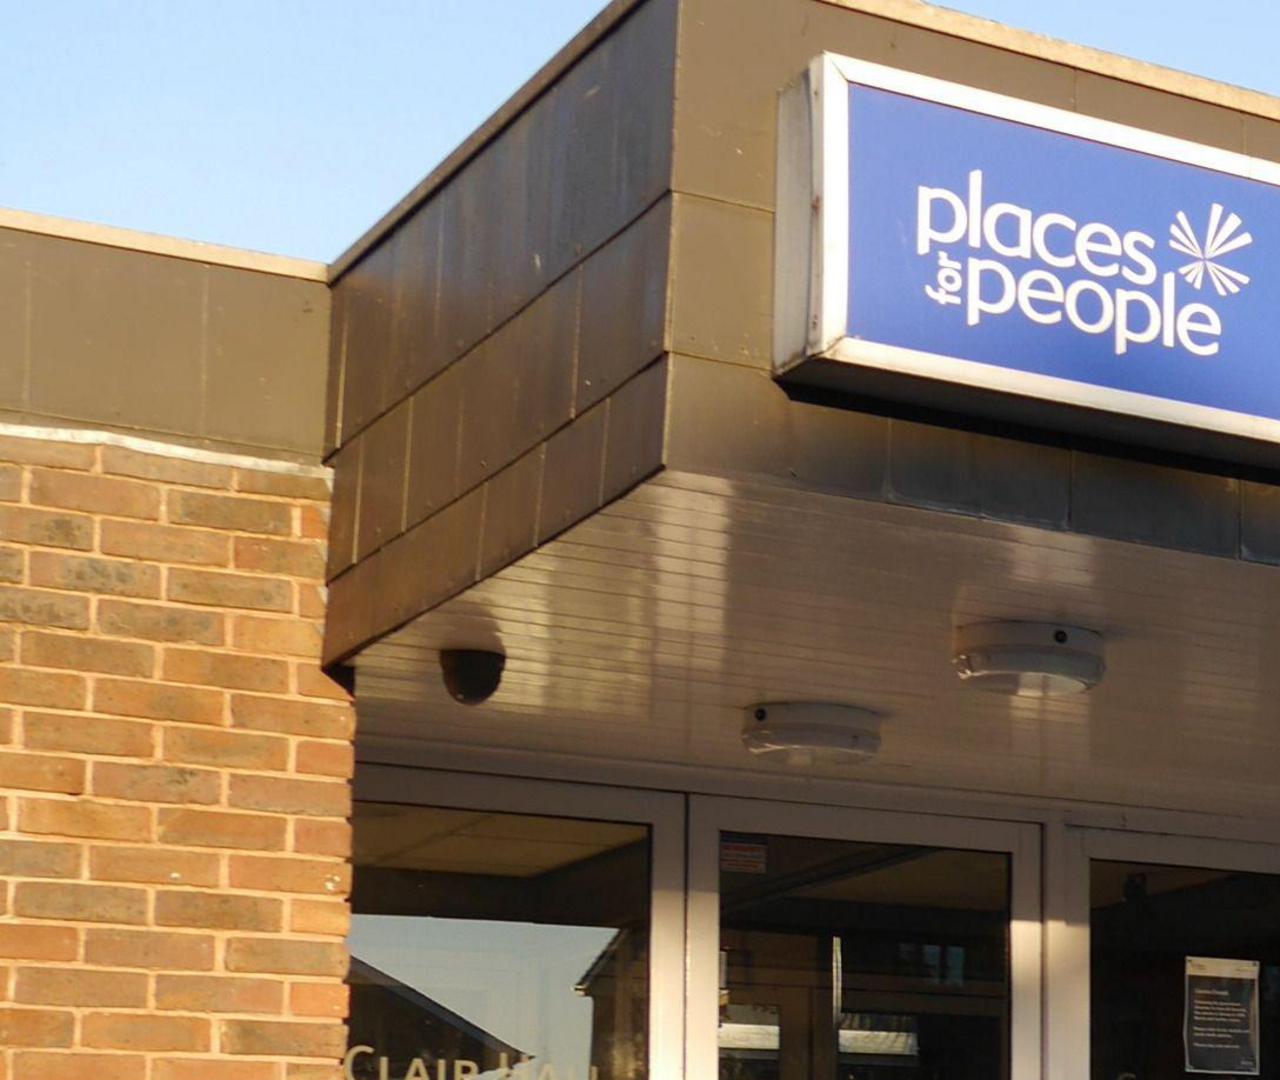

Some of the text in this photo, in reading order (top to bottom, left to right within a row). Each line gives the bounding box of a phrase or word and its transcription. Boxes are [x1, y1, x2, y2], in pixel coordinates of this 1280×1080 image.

[916, 169, 1157, 286] places
[925, 252, 963, 305] for
[968, 257, 1222, 355] people
